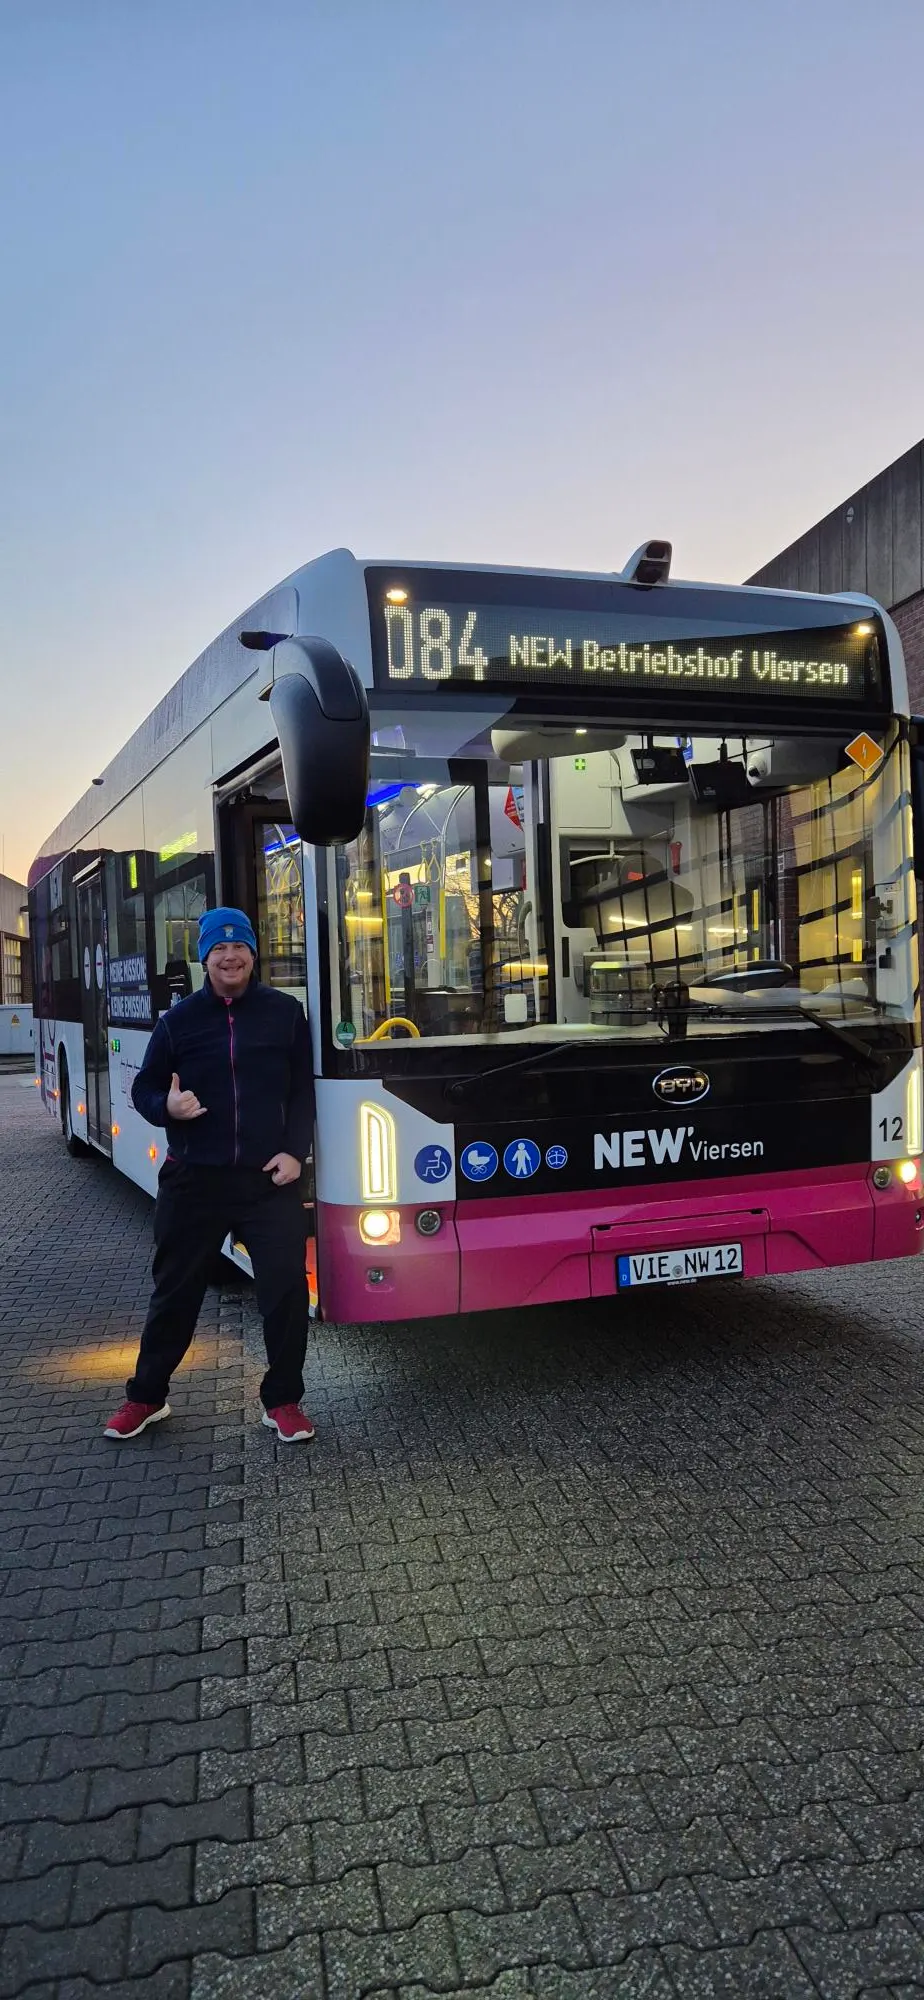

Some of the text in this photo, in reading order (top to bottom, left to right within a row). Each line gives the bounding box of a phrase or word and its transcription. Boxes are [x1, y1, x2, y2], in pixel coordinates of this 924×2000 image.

[384, 605, 849, 685] 084 NEW Betriebshof Viersen
[657, 1077, 705, 1094] BYD
[878, 1116, 904, 1143] 12
[689, 1139, 765, 1162] Viersen
[632, 1256, 671, 1280] VIE
[684, 1251, 710, 1275] NW
[714, 1247, 739, 1271] 12
